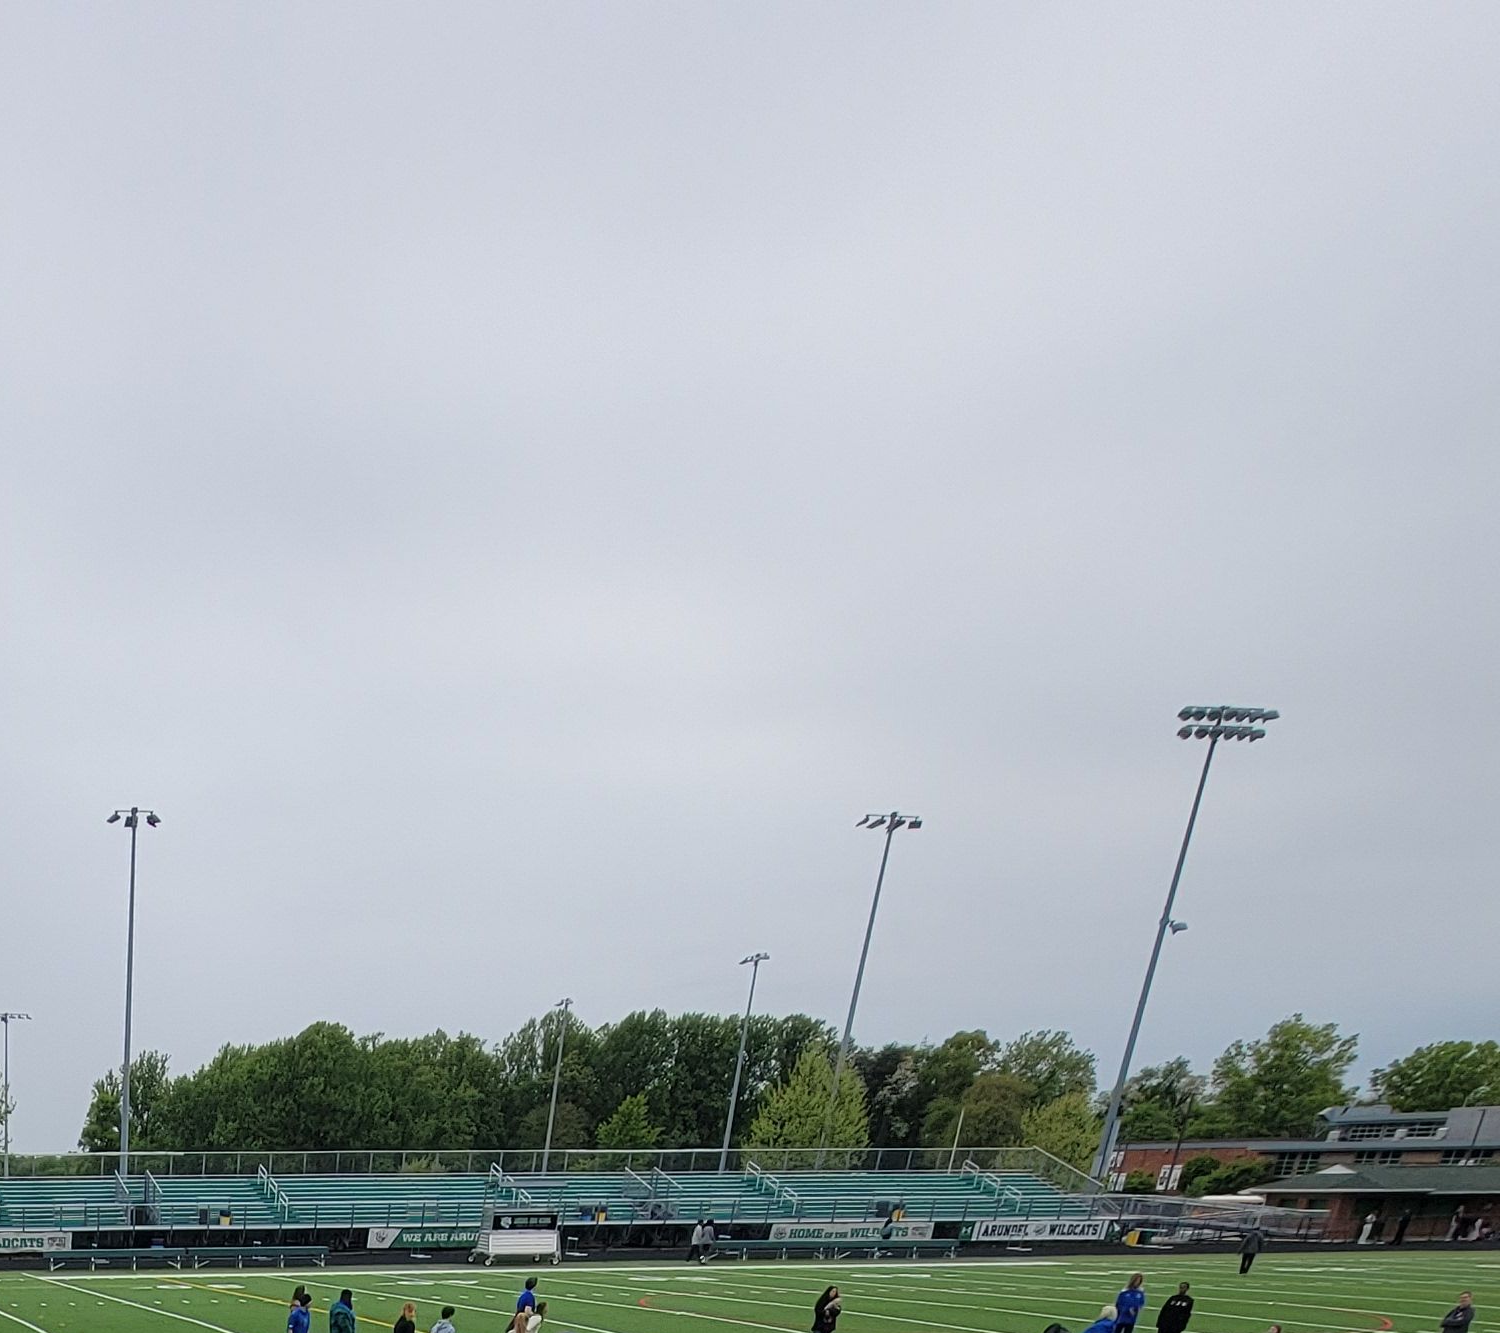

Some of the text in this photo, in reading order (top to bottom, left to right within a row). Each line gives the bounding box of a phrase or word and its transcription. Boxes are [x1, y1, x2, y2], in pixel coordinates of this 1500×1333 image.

[788, 1228, 824, 1239] HOME
[850, 1227, 909, 1238] WILDTS
[1048, 1223, 1100, 1236] WILDCATS
[402, 1232, 421, 1242] WE
[424, 1231, 448, 1242] ARE
